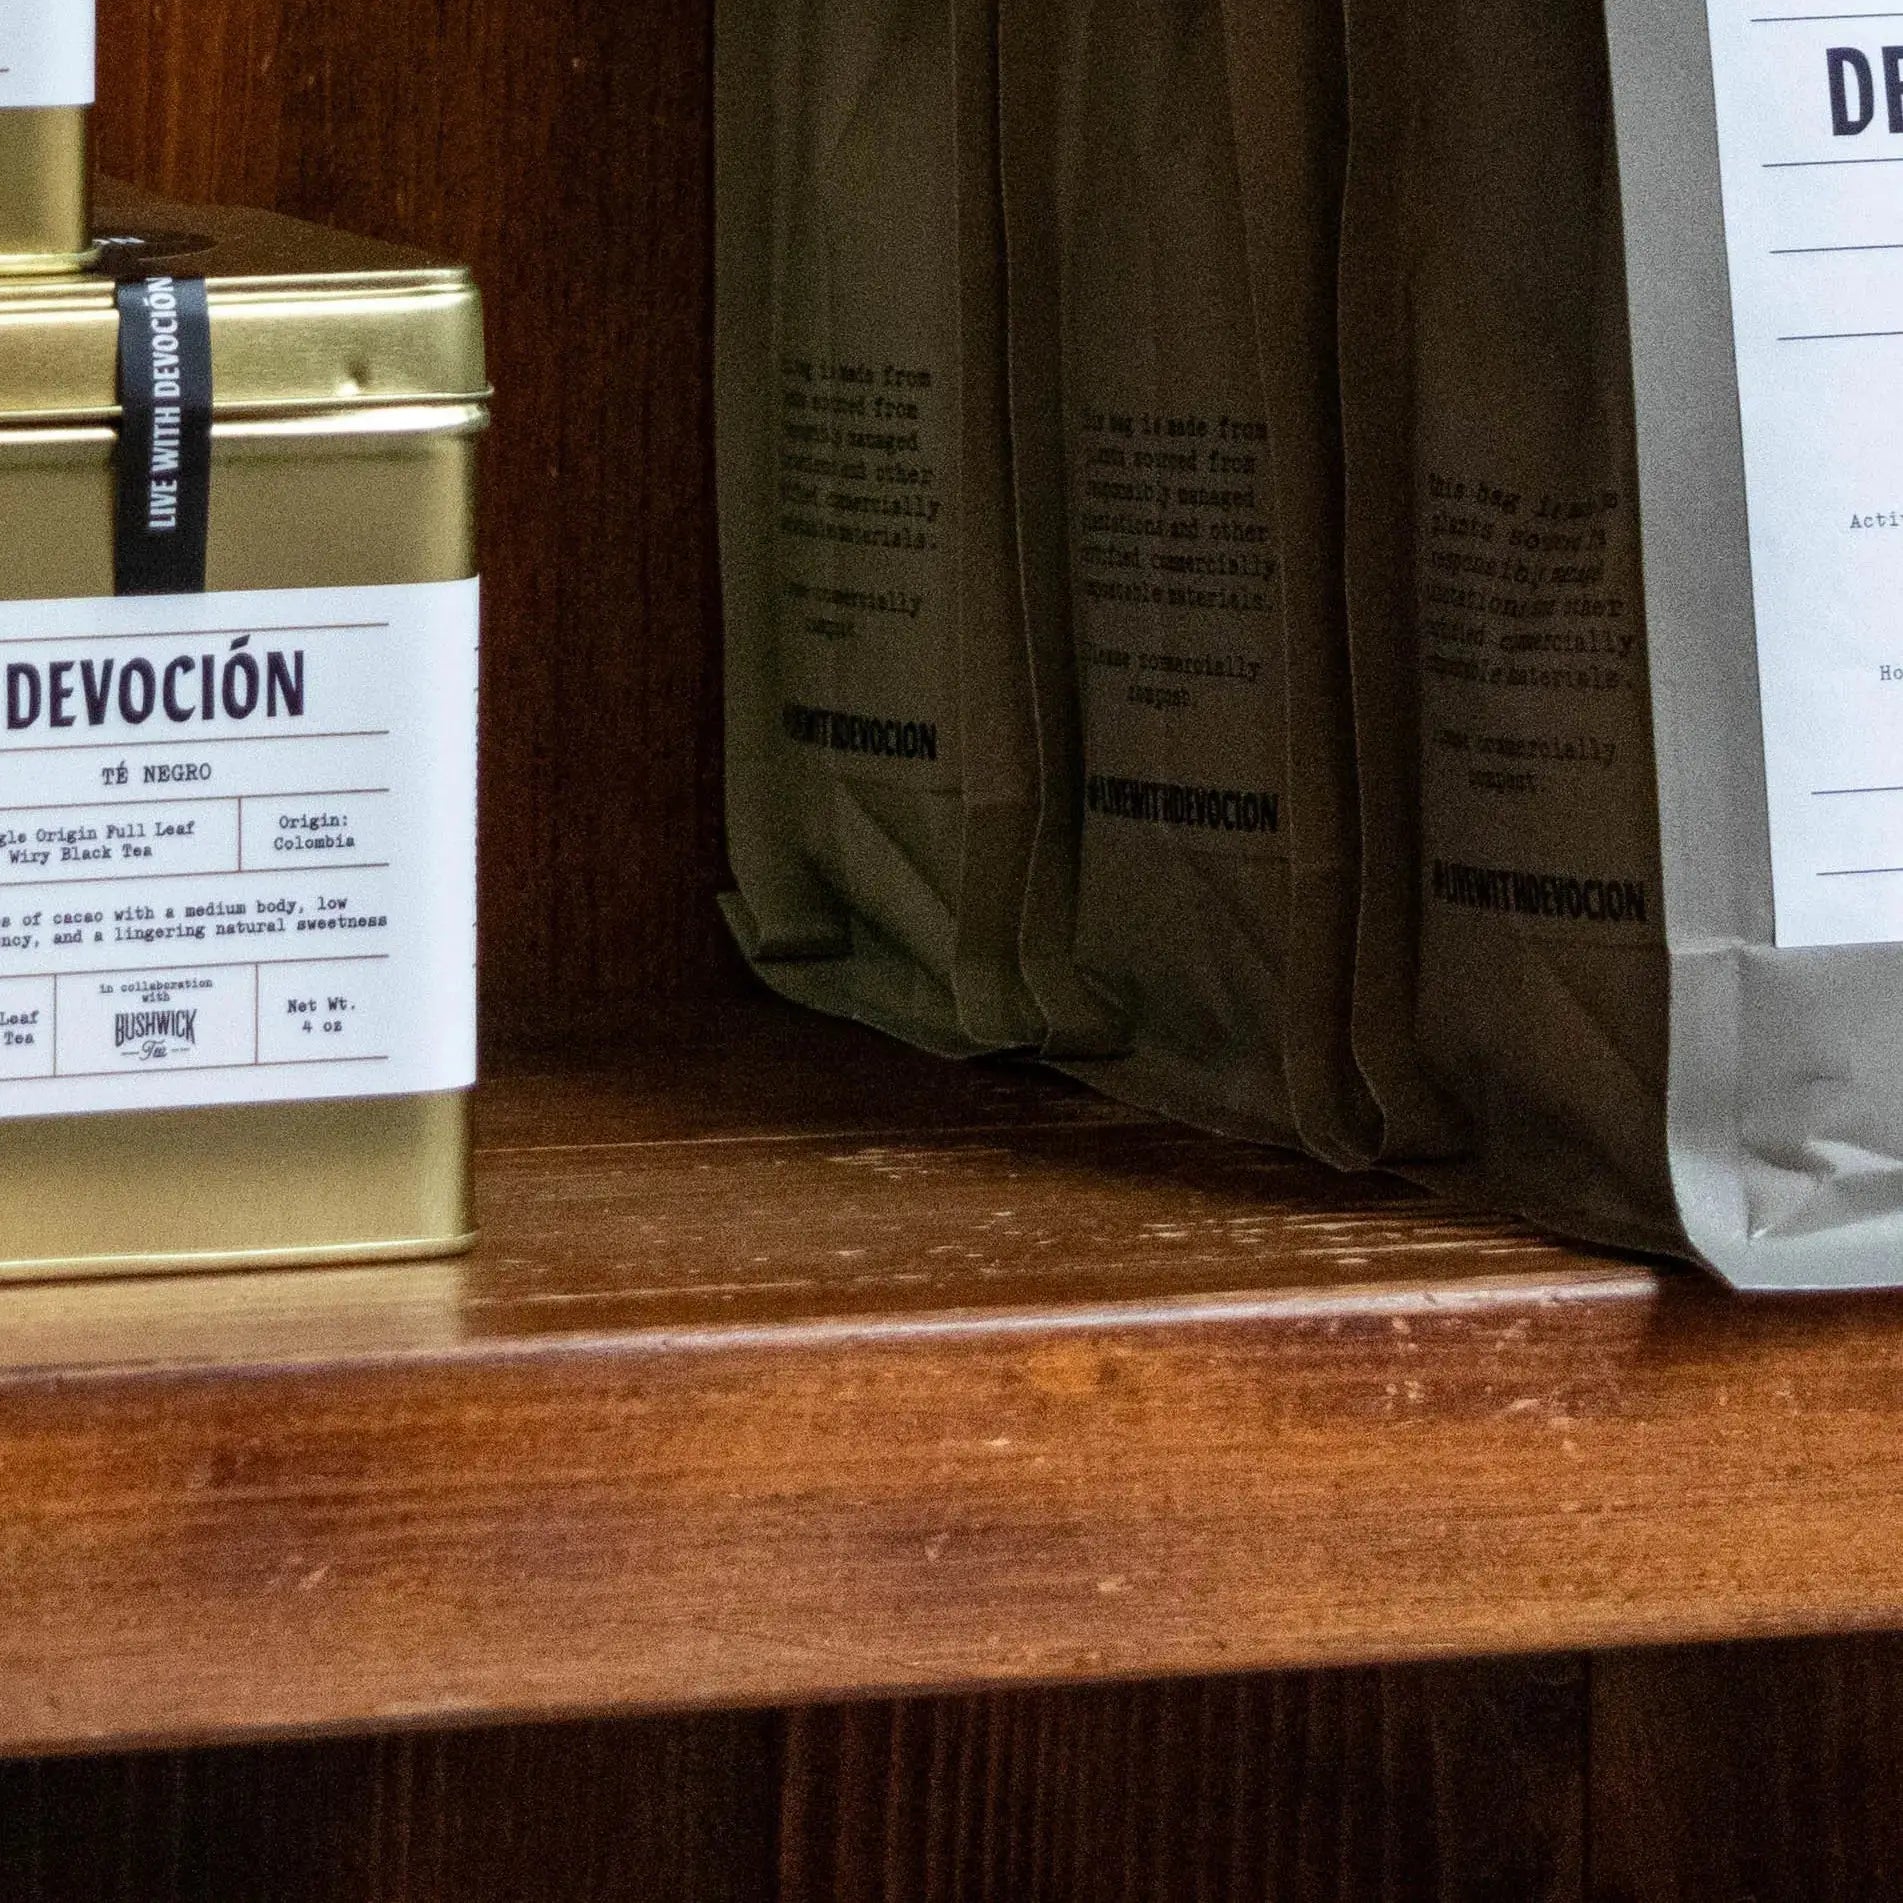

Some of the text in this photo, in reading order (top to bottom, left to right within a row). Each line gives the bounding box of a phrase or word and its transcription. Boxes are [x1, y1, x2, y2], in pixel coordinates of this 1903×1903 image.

[143, 277, 180, 529] LIVE WITH DEVOCIÓN
[1220, 416, 1267, 440] from
[1209, 449, 1256, 474] from
[1849, 511, 1903, 529] Acti
[6, 635, 304, 730] DEVOCIÓN
[101, 760, 212, 786] TÉ NEGRO
[36, 826, 97, 845] Origin
[106, 823, 146, 839] Full
[154, 820, 195, 837] Leaf
[279, 813, 347, 831] Origin:
[273, 833, 355, 851] Colombia
[8, 843, 152, 866] Wiry Black Tea
[22, 911, 42, 927] of
[53, 911, 103, 925] cacao
[114, 906, 155, 922] with
[165, 908, 175, 919] a
[184, 902, 247, 918] medium
[256, 898, 304, 916] body,
[317, 896, 348, 911] low
[52, 929, 83, 945] and
[94, 931, 103, 943] a
[115, 923, 206, 943] lingering
[215, 917, 286, 936] natural
[296, 914, 388, 931] sweetness
[286, 997, 355, 1014] Net Wt.
[3, 1030, 35, 1046] Tea
[115, 1009, 196, 1048] BUSHWICK
[302, 1020, 342, 1033] 4 oz
